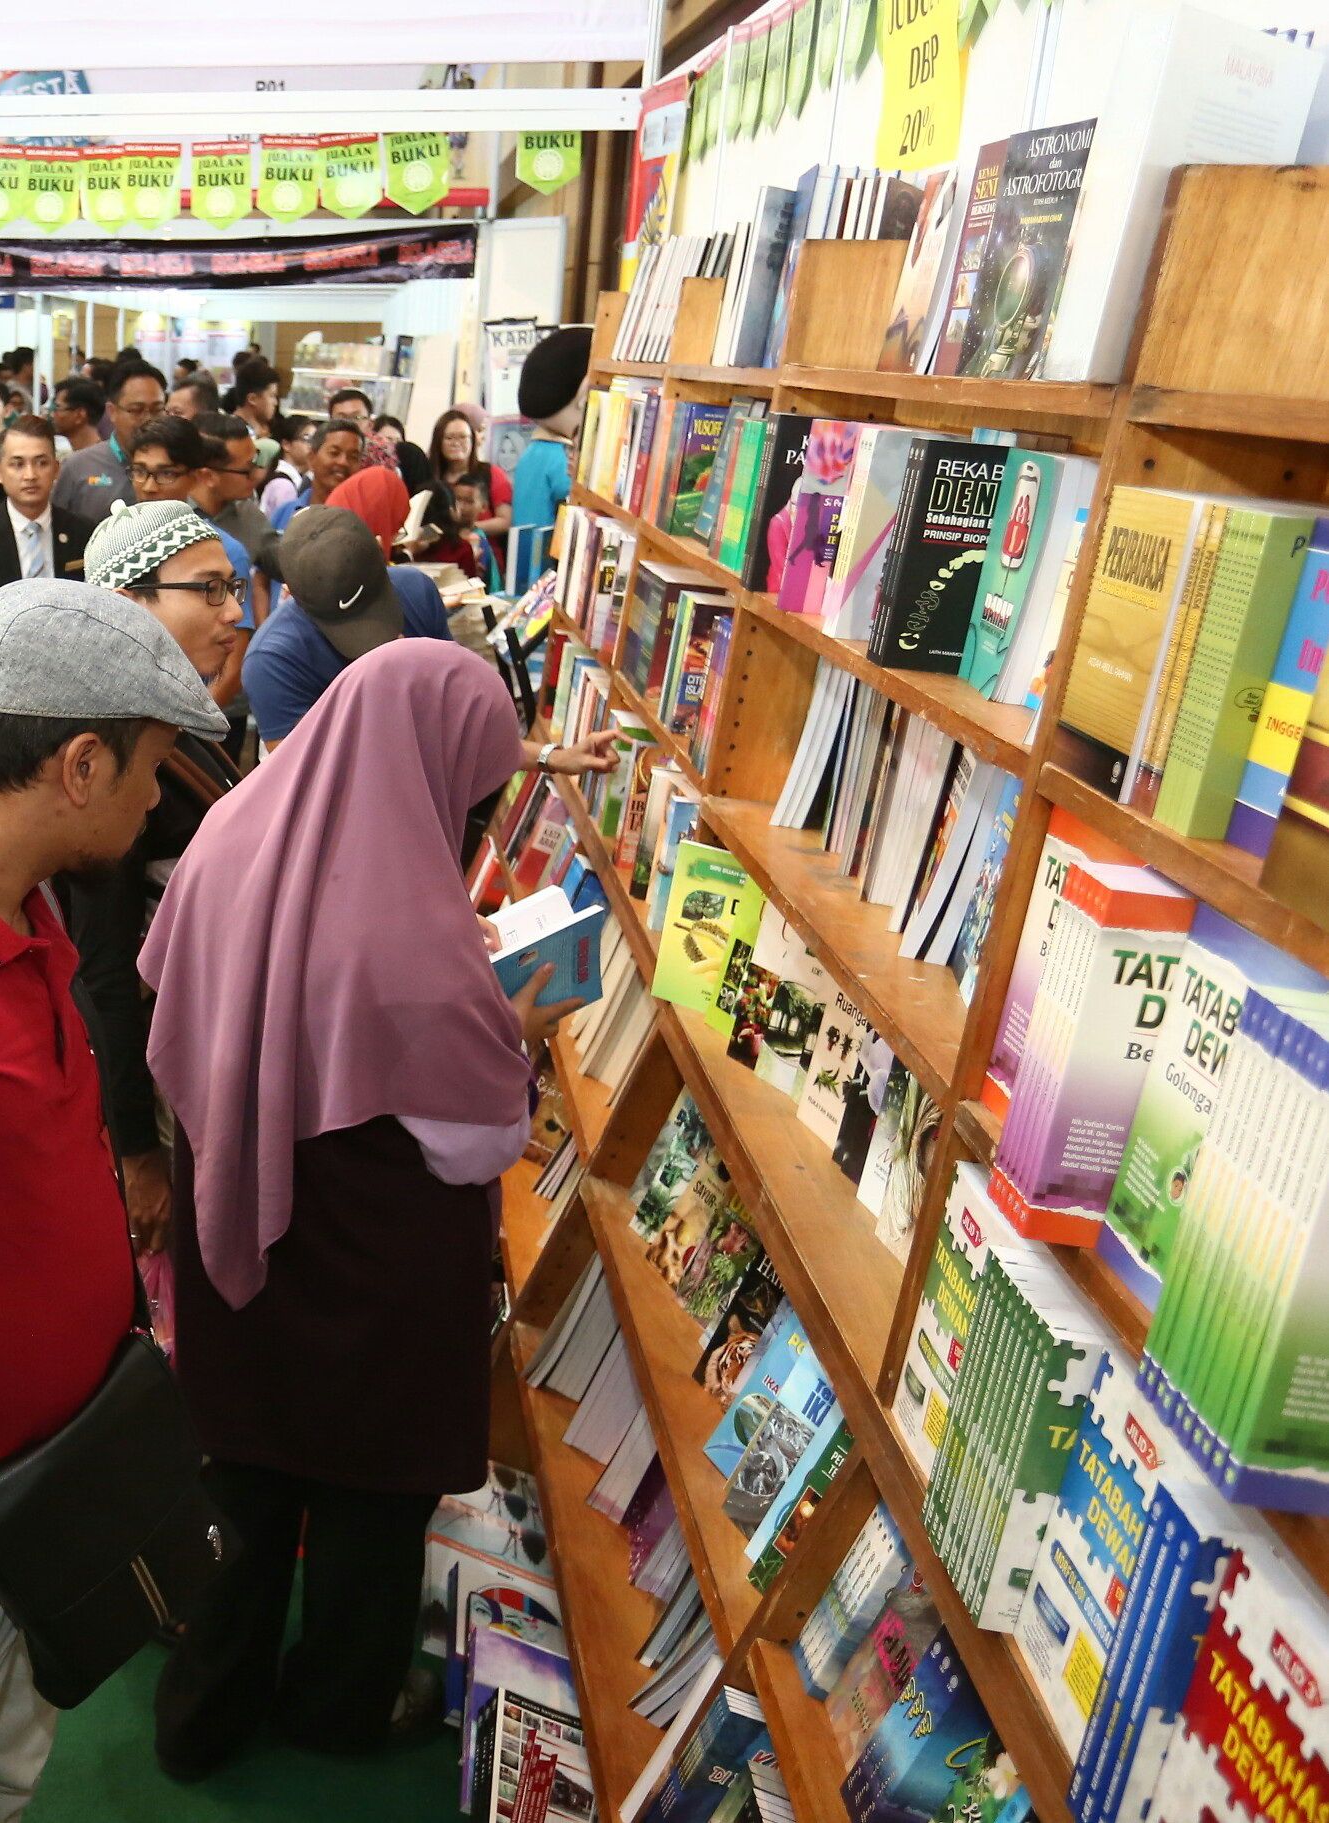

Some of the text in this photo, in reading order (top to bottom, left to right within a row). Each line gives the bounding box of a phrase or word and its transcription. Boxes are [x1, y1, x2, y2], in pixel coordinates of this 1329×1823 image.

[909, 34, 939, 89] DBP
[899, 103, 935, 156] 20%
[326, 146, 372, 160] JUALAN
[525, 134, 575, 150] BUKU
[1026, 127, 1096, 159] ASTRONOMI
[129, 158, 174, 170] JUALAN
[198, 157, 244, 170] JUALAN
[268, 151, 313, 163] JUALAN
[391, 144, 441, 164] BUKU
[1048, 157, 1063, 170] dan
[29, 163, 73, 175] JUALAN
[88, 161, 122, 172] JUALA
[265, 167, 313, 182] BUKU
[326, 162, 375, 179] BUKU
[27, 178, 75, 192] BUKU
[87, 176, 121, 190] BUK
[127, 173, 175, 188] BUKU
[197, 172, 245, 187] BUKU
[973, 177, 999, 200] SENI
[1003, 168, 1083, 198] ASTROFOTOGR
[935, 458, 1005, 481] REKA B
[928, 477, 999, 517] DEN
[925, 512, 986, 529] Sebahagian
[923, 529, 988, 545] PRINSIP BIOP
[1265, 716, 1302, 741] INGGE
[1112, 948, 1181, 992] TAT
[835, 990, 870, 1028] Ruanga
[1135, 994, 1167, 1030] D
[1179, 965, 1244, 1038] TATAB
[1124, 1041, 1154, 1063] Be
[1183, 1018, 1230, 1076] DEW
[1165, 1061, 1213, 1116] Golonga
[1064, 1143, 1123, 1158] Abdul Hamid Mah
[1061, 1160, 1079, 1170] Abdul
[692, 1179, 718, 1209] SAYUR
[934, 1238, 978, 1313] TATABAHA
[762, 1374, 781, 1397] IKA
[1127, 1421, 1148, 1457] JILID
[830, 1450, 845, 1467] PE
[1077, 1437, 1145, 1546] TATABAH
[1209, 1649, 1329, 1823] TATABAHA
